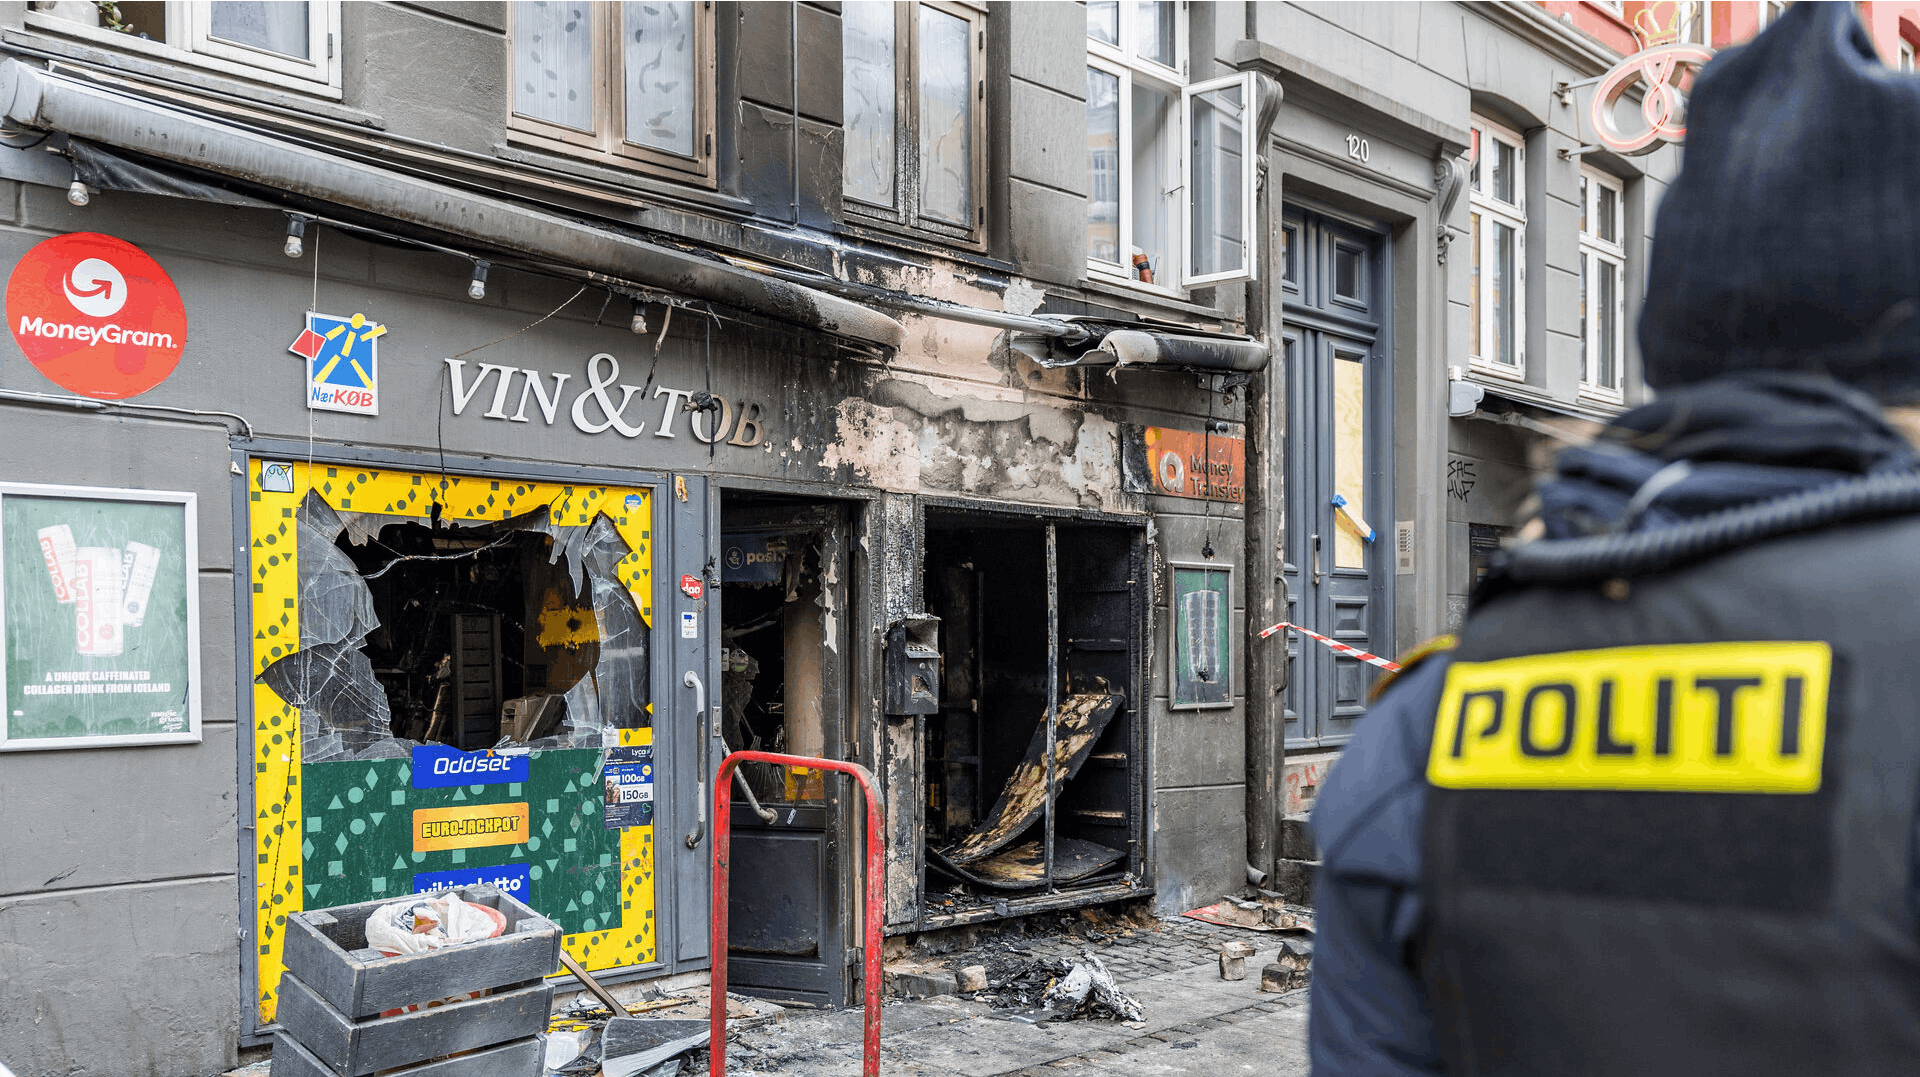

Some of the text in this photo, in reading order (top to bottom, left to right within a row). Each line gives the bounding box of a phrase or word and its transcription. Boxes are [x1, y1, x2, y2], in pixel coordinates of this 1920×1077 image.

[1346, 134, 1369, 162] 120
[1190, 453, 1233, 480] Money
[1190, 477, 1244, 499] Transfer
[45, 670, 151, 683] A UNIQUE CAFFEINATED
[23, 683, 171, 695] COLLAGEN DRINK FROM ICELAND
[1449, 676, 1804, 759] POLITI
[631, 748, 647, 756] Lyca
[433, 756, 511, 775] Oddset
[622, 789, 649, 800] 150GB
[421, 815, 520, 838] EUROJACKPOT
